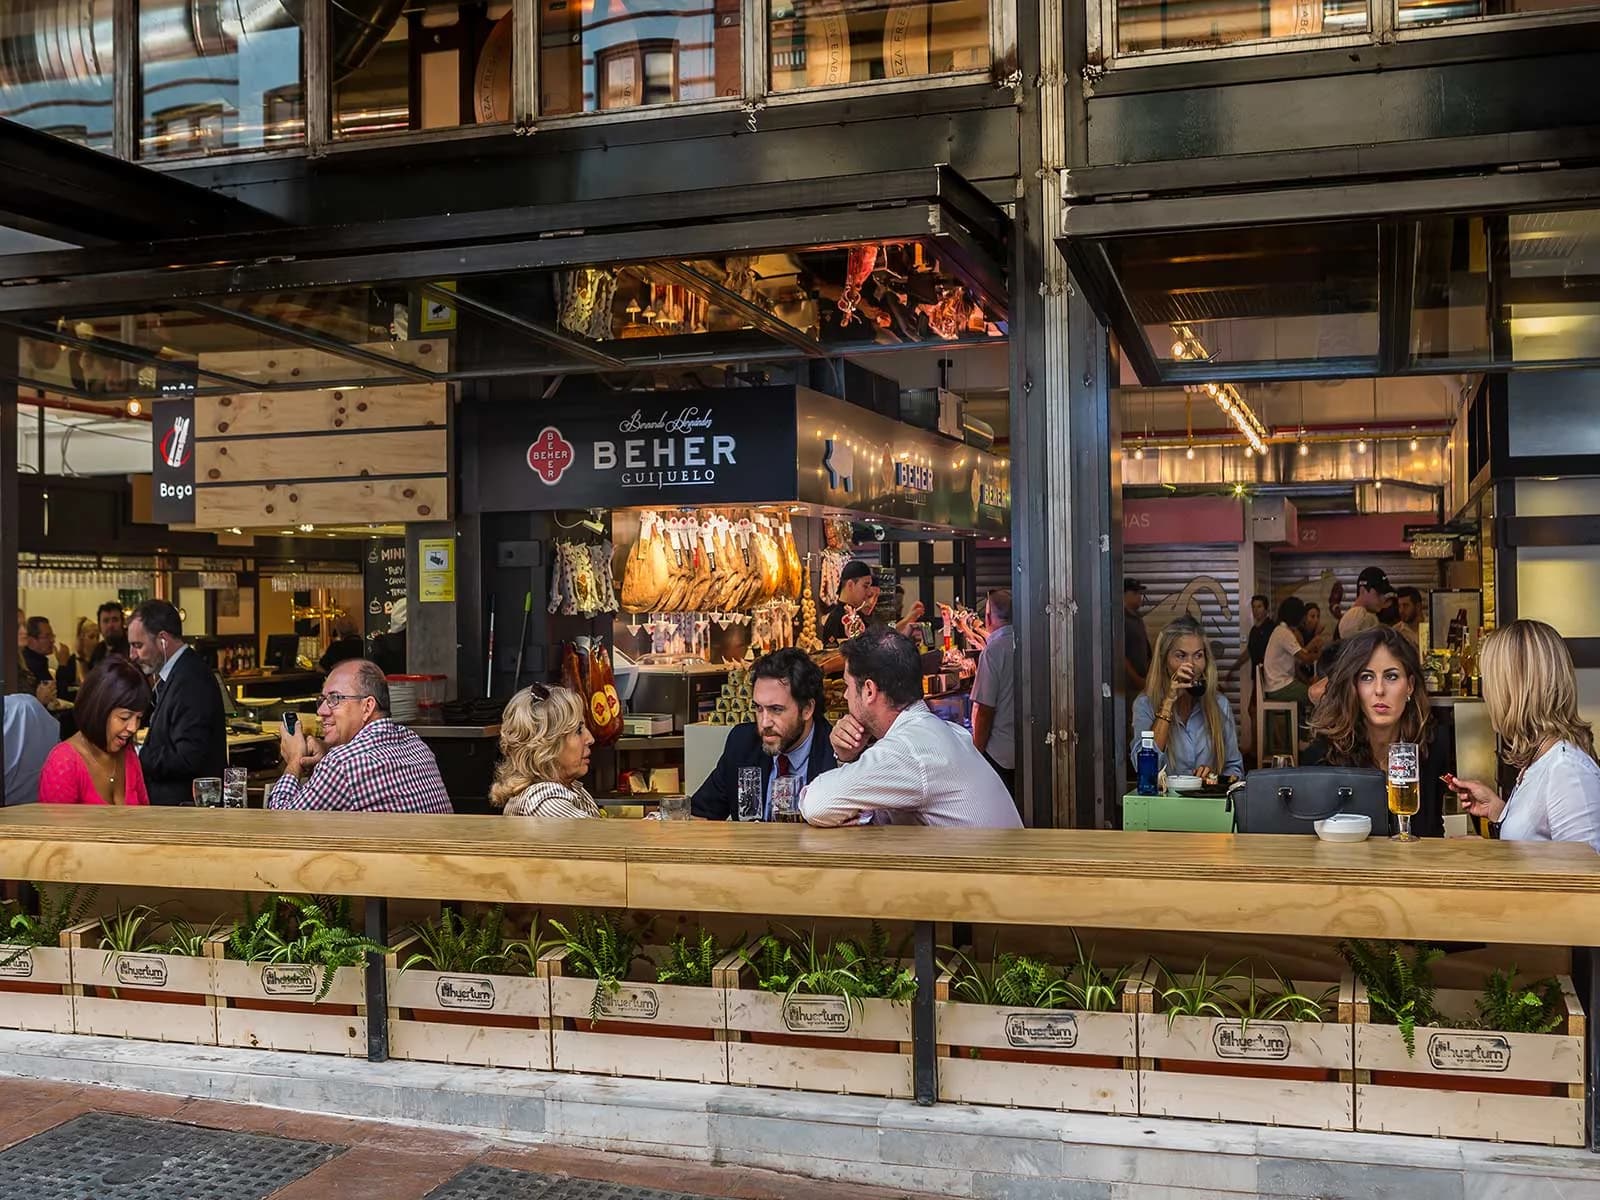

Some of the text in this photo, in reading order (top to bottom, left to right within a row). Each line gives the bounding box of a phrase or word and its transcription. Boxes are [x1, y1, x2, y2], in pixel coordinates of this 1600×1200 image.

[532, 451, 568, 460] BEHER
[593, 435, 737, 470] BEHER
[621, 469, 716, 490] GUIJUELO
[897, 463, 934, 492] BEHER
[160, 482, 193, 499] Baga
[1302, 530, 1317, 541] 22
[381, 548, 406, 561] MINI
[127, 962, 163, 977] huertum
[449, 983, 490, 999] huertum
[1022, 1020, 1072, 1036] huertum
